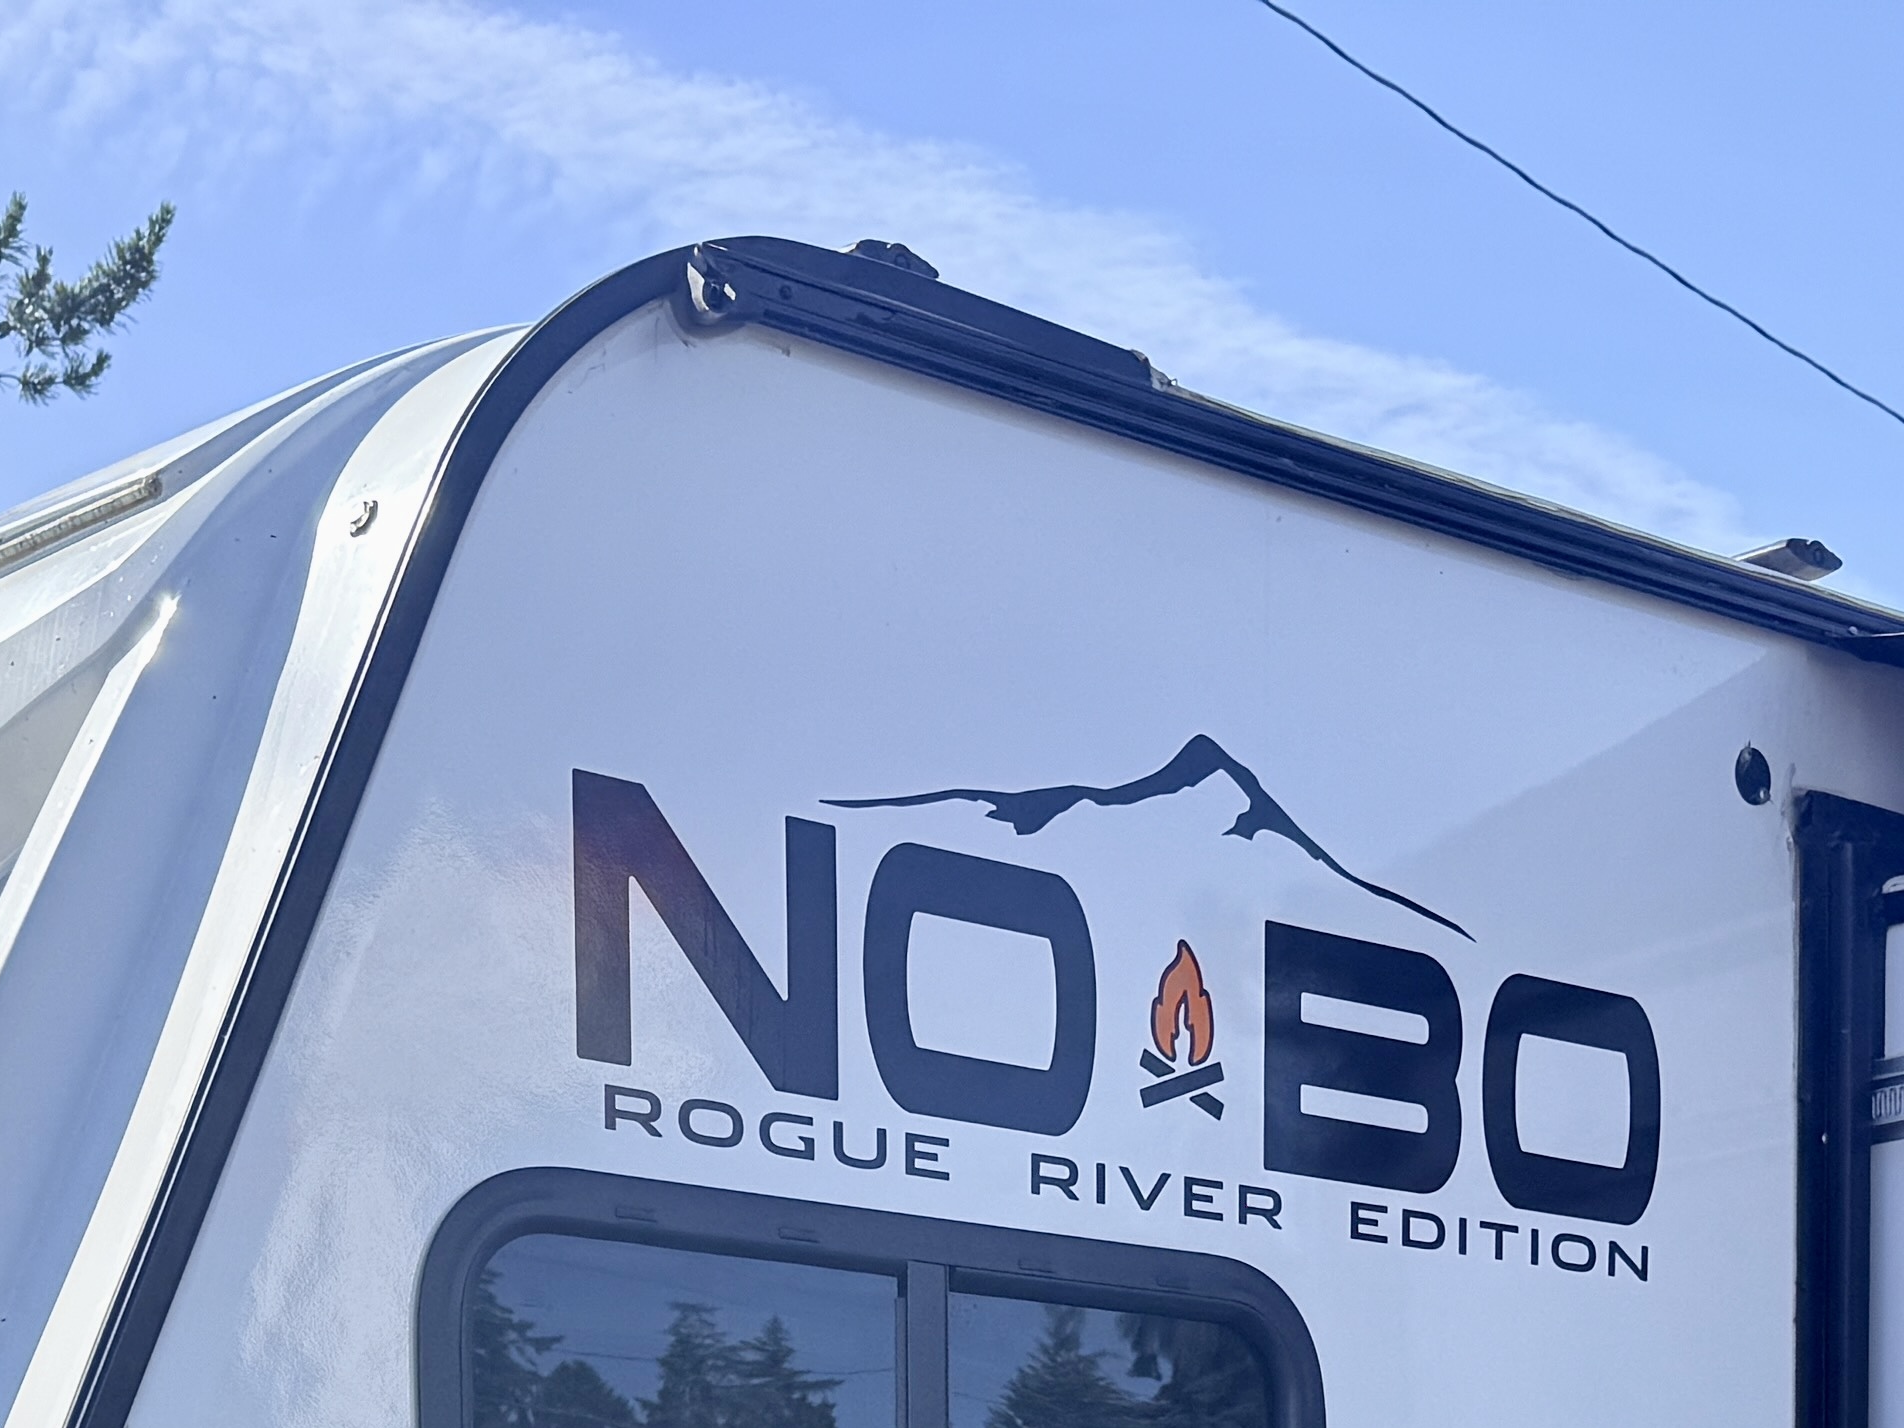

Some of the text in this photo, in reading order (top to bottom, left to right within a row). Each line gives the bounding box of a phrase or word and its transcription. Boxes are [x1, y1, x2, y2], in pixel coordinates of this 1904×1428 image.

[572, 768, 1662, 1226] NO BO
[603, 1083, 1651, 1283] ROGUE RIVER EDITION
